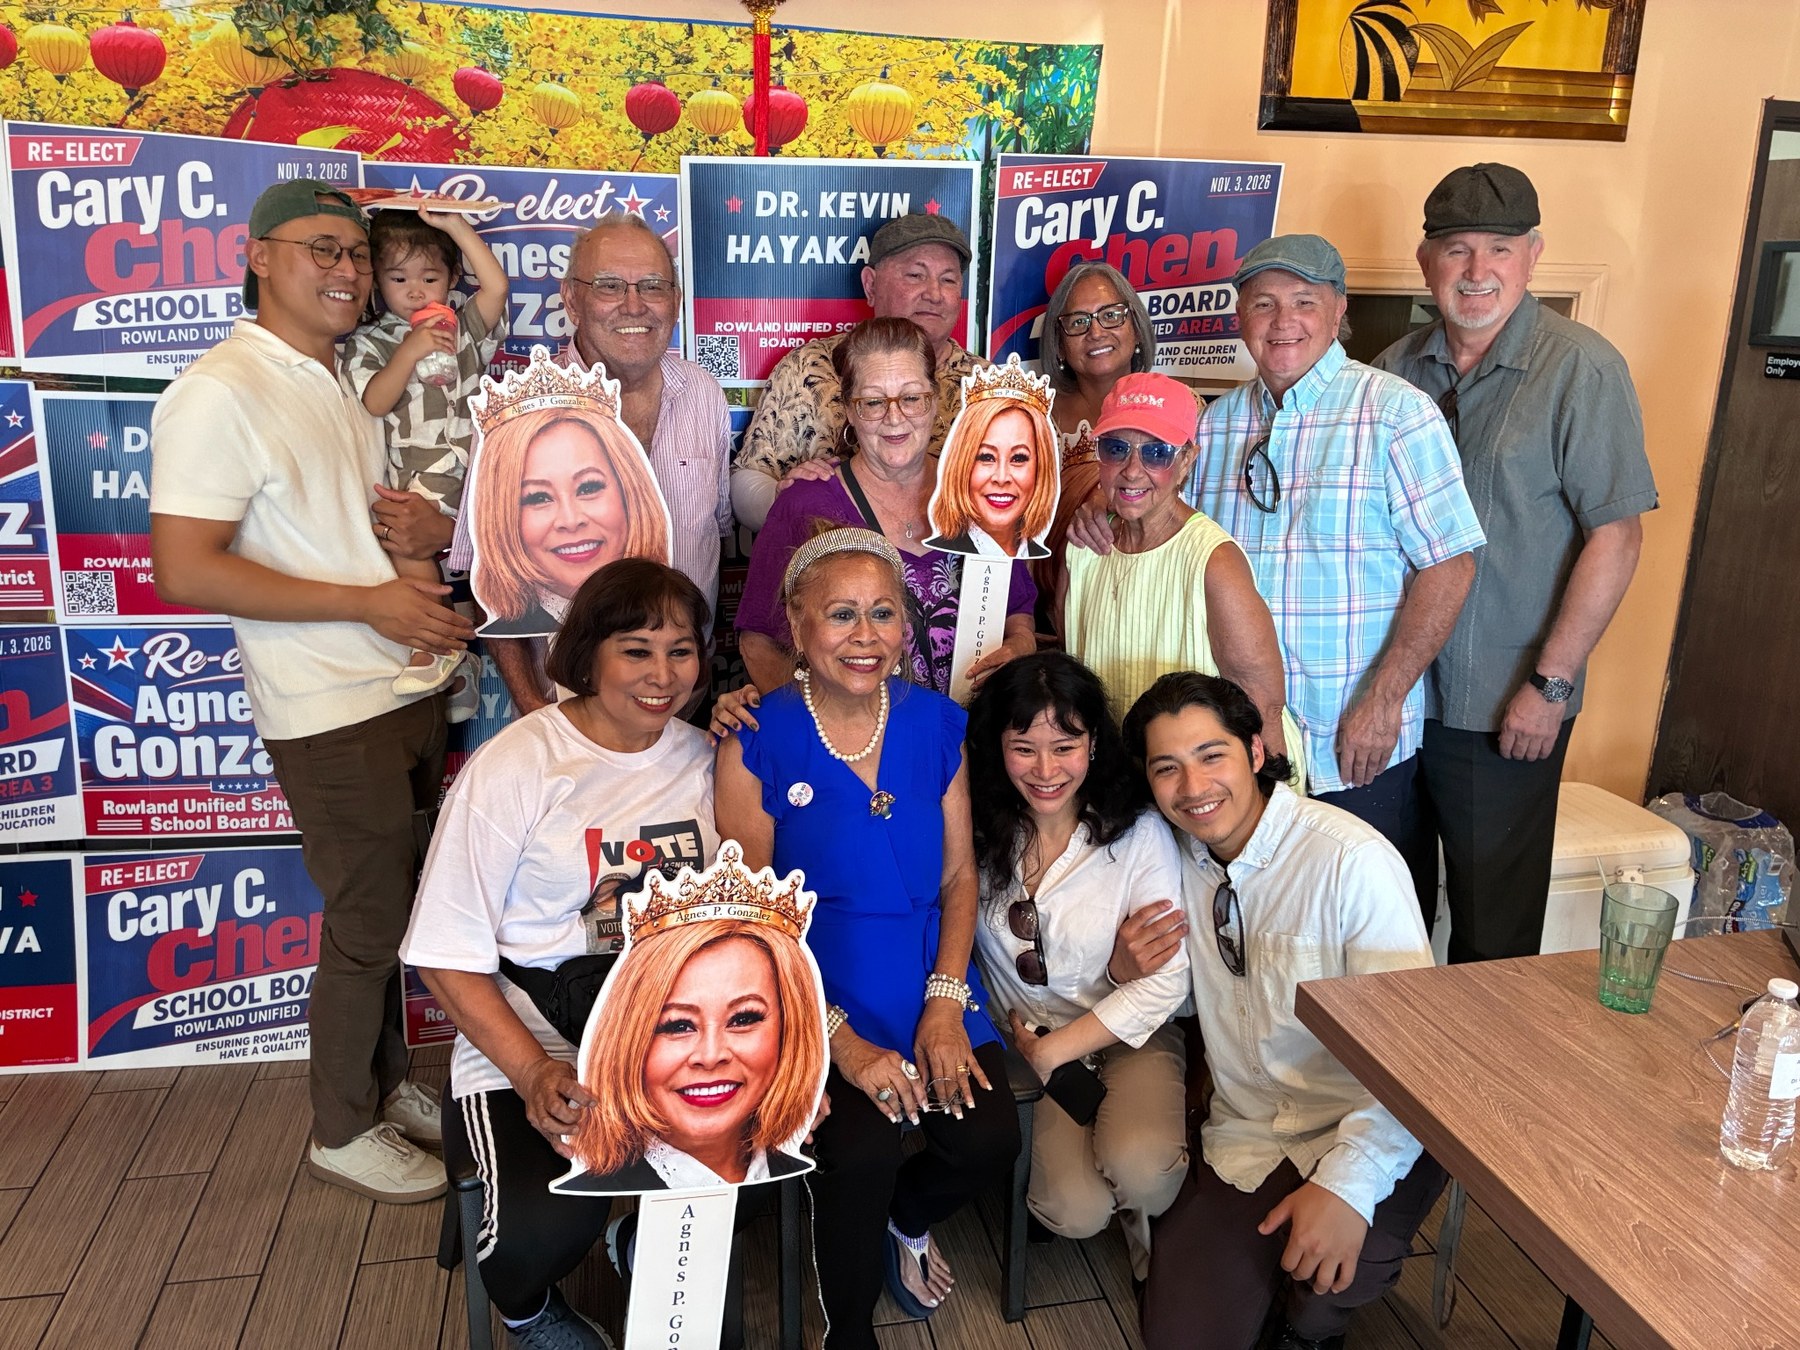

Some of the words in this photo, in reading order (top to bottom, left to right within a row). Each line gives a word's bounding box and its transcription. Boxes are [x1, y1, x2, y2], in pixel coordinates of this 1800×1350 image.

[27, 142, 127, 163] RE-ELECT
[277, 163, 303, 180] NOV.
[306, 164, 317, 181] 3,
[319, 163, 348, 180] 2026
[1012, 168, 1093, 190] RE-ELECT
[1210, 177, 1232, 193] NOV.
[1235, 176, 1244, 193] 3,
[1246, 174, 1271, 191] 2026
[37, 170, 165, 235] Cary
[177, 160, 227, 219] C.
[755, 190, 809, 218] DR.
[818, 191, 911, 219] KEVIN
[1014, 194, 1119, 250] Cary
[1125, 180, 1165, 233] C.
[1045, 228, 1242, 296] Chen
[94, 294, 218, 326] SCHOOL
[1148, 289, 1231, 317] BOARD
[121, 328, 200, 345] ROWLAND
[714, 321, 781, 333] ROWLAND
[784, 321, 833, 333] UNIFIED
[1152, 323, 1174, 336] IED
[1177, 318, 1224, 335] AREA
[1229, 316, 1240, 331] 3
[759, 337, 805, 348] BOARD
[1184, 345, 1237, 355] CHILDREN
[1179, 356, 1236, 366] EDUCATION
[1766, 366, 1786, 377] Only
[1768, 357, 1800, 367] Employ
[511, 403, 535, 415] Agnes
[539, 398, 547, 406] P.
[550, 397, 587, 406] Gonzalez
[981, 565, 992, 612] Agnes
[978, 616, 986, 626] P.
[23, 635, 52, 652] 2026
[134, 685, 252, 733] Agne
[42, 775, 54, 791] 3
[103, 799, 178, 815] Rowland
[184, 797, 246, 814] Unified
[150, 815, 211, 832] School
[217, 814, 269, 830] Board
[600, 832, 699, 867] VOTE
[101, 861, 190, 886] RE-ELECT
[107, 884, 223, 942] Cary
[233, 868, 276, 918] C.
[675, 909, 707, 923] Agnes
[713, 906, 723, 916] P.
[727, 905, 771, 921] Gonzalez
[153, 982, 262, 1022] SCHOOL
[174, 1014, 245, 1038] ROWLAND
[249, 1004, 301, 1028] UNIFIED
[195, 1036, 250, 1053] ENSURING
[253, 1028, 310, 1044] ROWLAND
[219, 1047, 248, 1060] HAVE
[251, 1046, 259, 1056] A
[262, 1039, 308, 1054] QUALITY
[677, 1203, 695, 1283] Agnes
[672, 1290, 685, 1306] P.
[668, 1314, 684, 1350] Go
